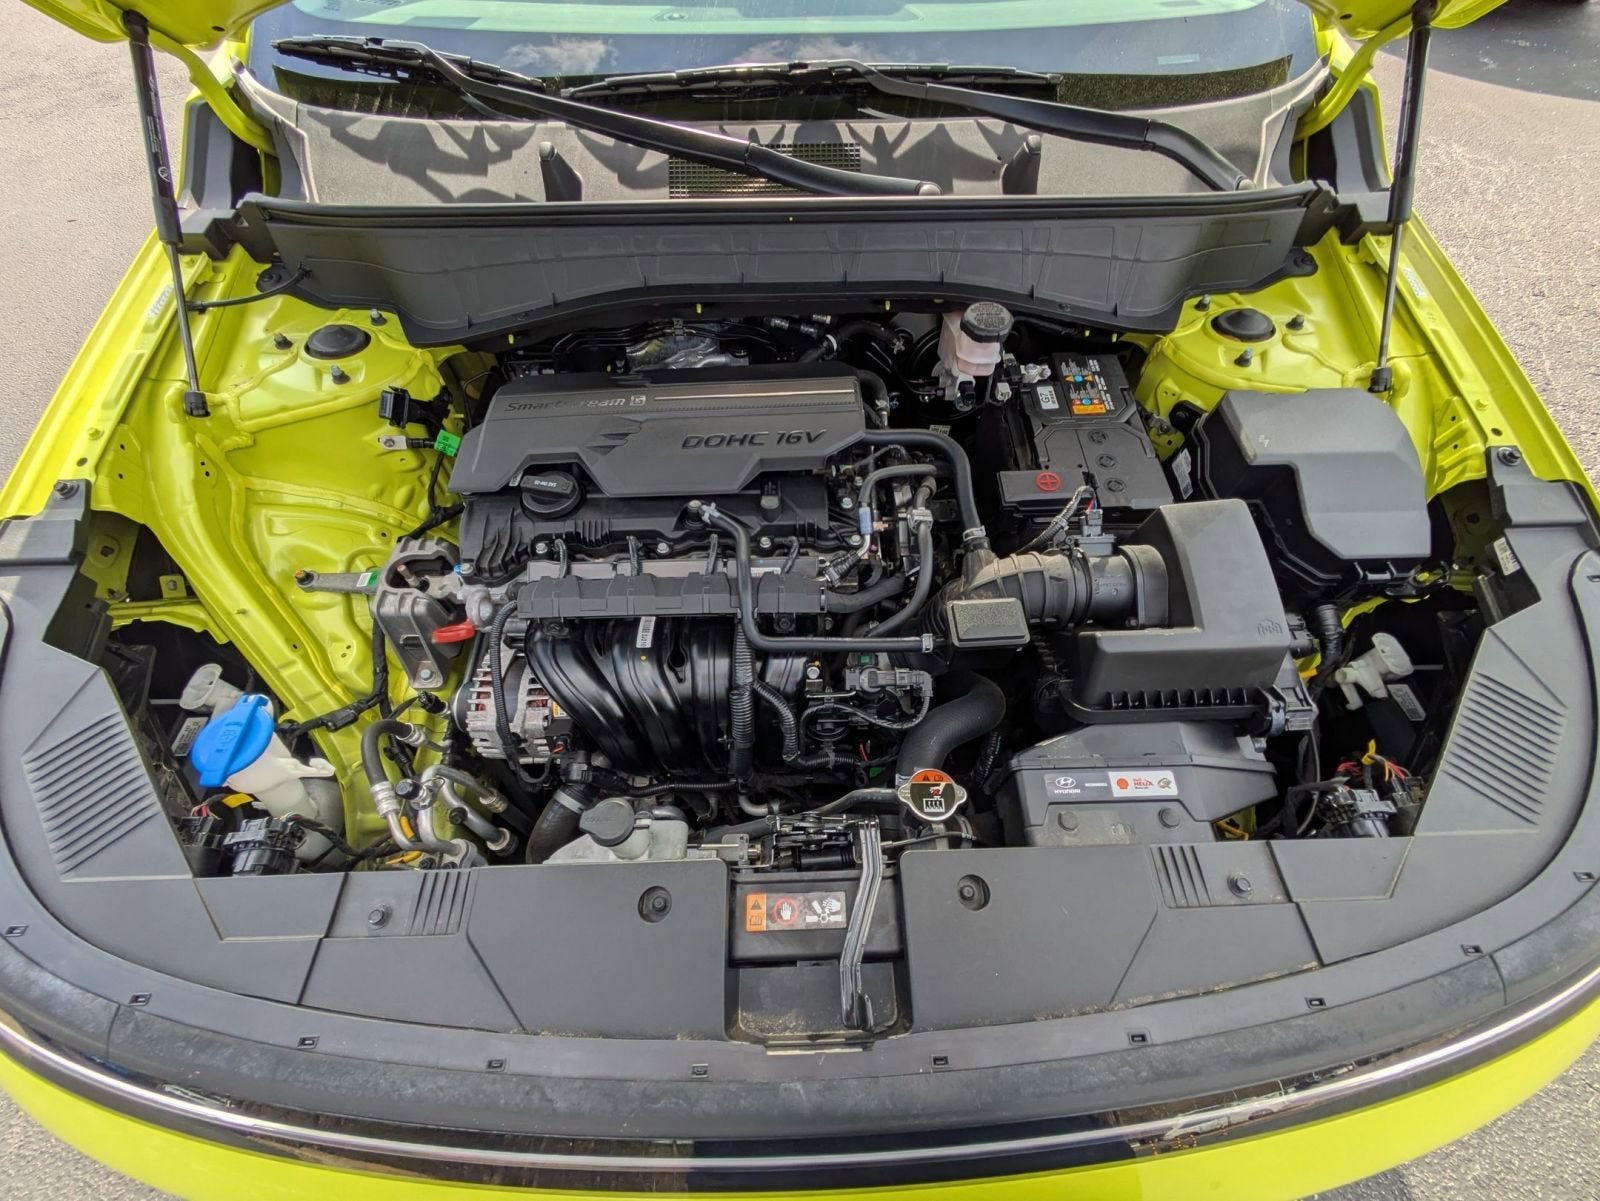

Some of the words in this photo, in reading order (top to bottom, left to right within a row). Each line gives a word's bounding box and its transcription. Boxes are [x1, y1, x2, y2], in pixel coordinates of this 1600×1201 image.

[1039, 392, 1051, 404] G7
[681, 431, 769, 449] DOHC
[776, 429, 828, 445] 16V
